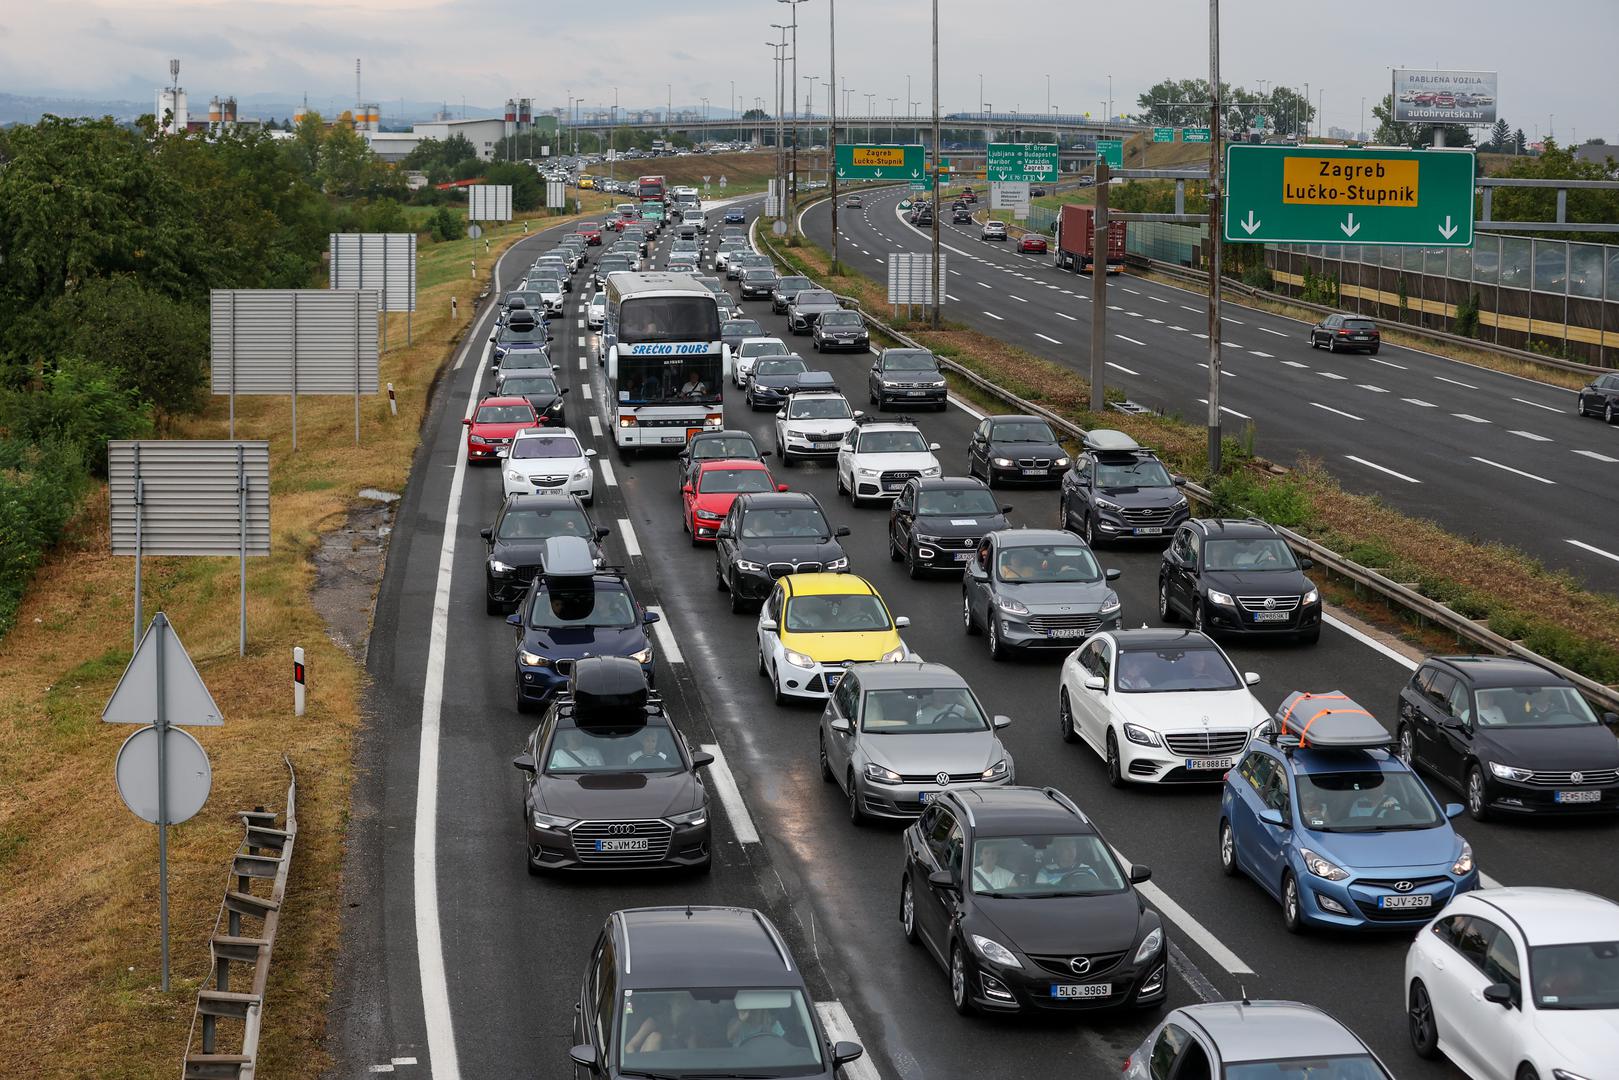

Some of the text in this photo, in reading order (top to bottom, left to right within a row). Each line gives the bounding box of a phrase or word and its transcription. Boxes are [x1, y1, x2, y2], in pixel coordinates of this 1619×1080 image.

[1408, 110, 1483, 118] autohrvatska.hr
[1320, 162, 1384, 180] Zagreb
[1286, 184, 1414, 204] Lučko-Stupnik
[632, 344, 708, 354] SREĆKO TOURS
[1385, 896, 1429, 906] SJV-257
[1060, 985, 1107, 996] 5L6 9969
